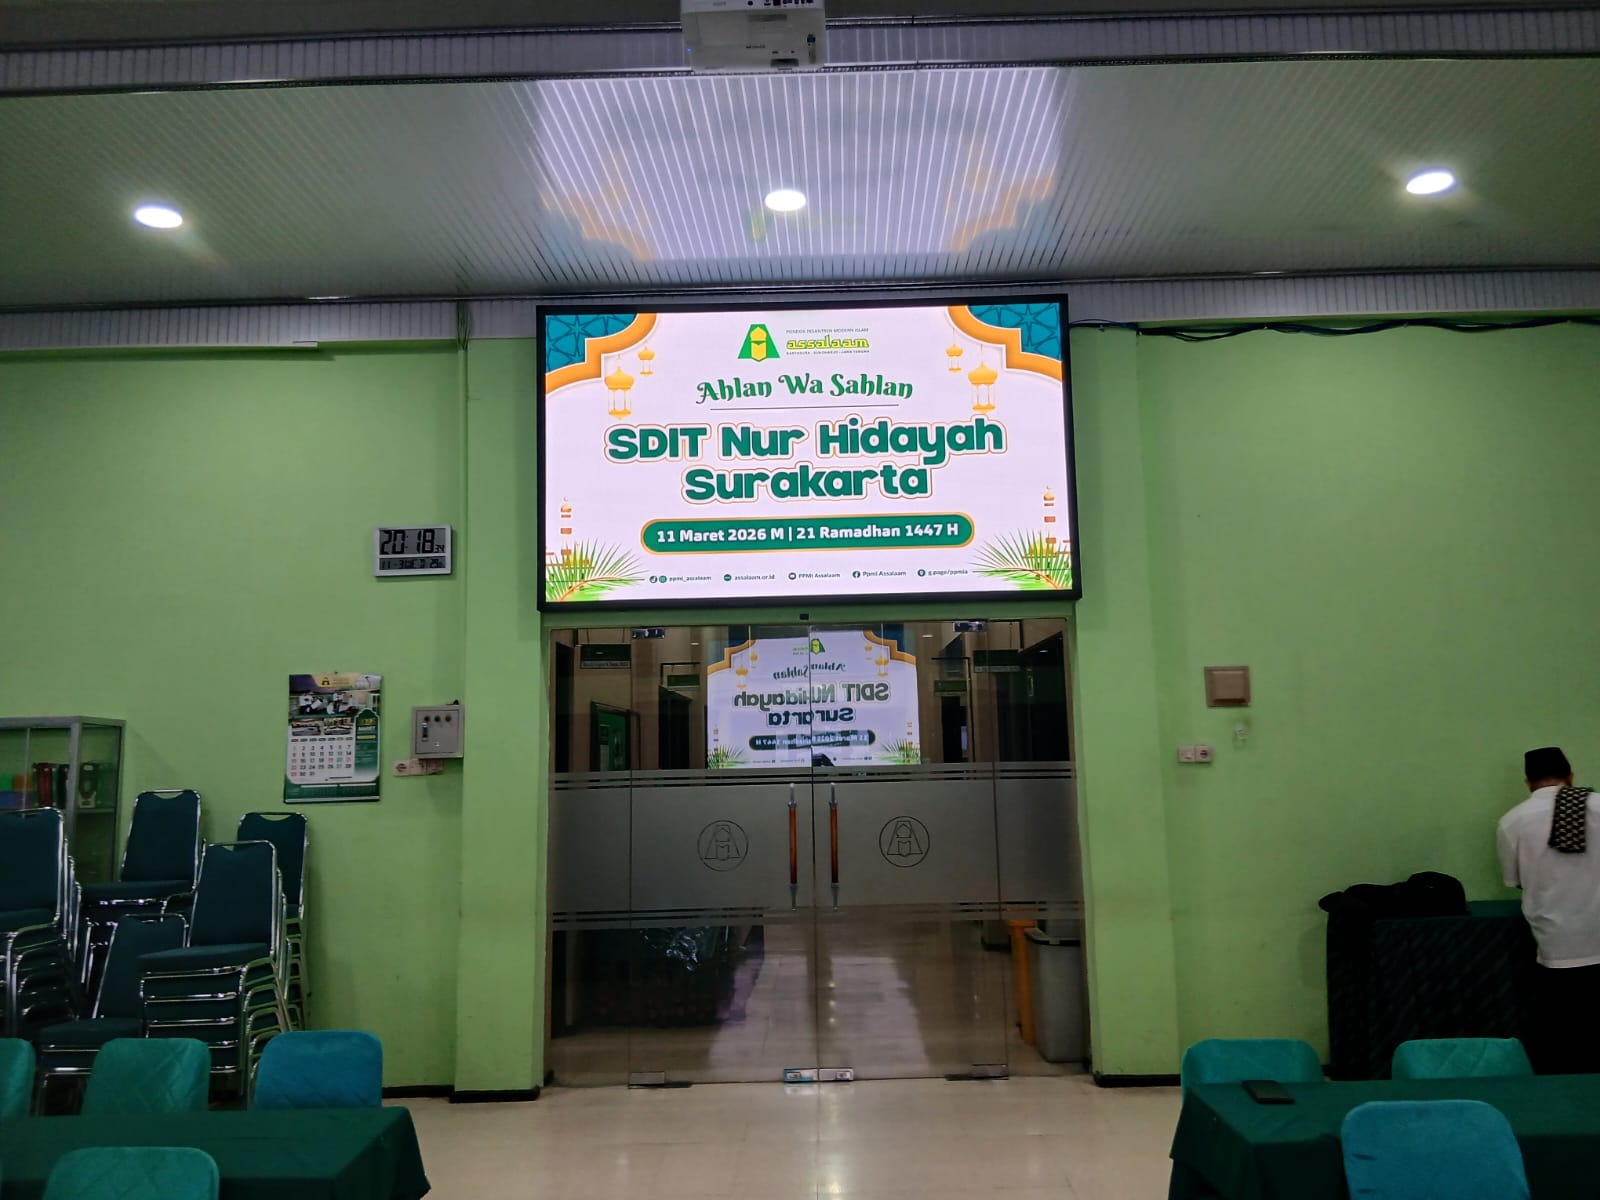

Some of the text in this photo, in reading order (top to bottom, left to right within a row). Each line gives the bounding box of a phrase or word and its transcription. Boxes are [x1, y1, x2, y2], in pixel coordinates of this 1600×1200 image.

[786, 334, 870, 350] assalaam
[695, 373, 913, 404] Ahlan Wa Sahlan
[607, 417, 1002, 465] SDIT Nur Hidayah
[684, 464, 928, 501] Surakarta
[657, 530, 676, 542] 11
[679, 529, 725, 542] Maret
[728, 528, 767, 541] 2026
[770, 527, 784, 540] M
[796, 527, 816, 539] 21
[819, 524, 900, 539] Ramadhan
[905, 523, 943, 537] 1447
[946, 523, 959, 535] H
